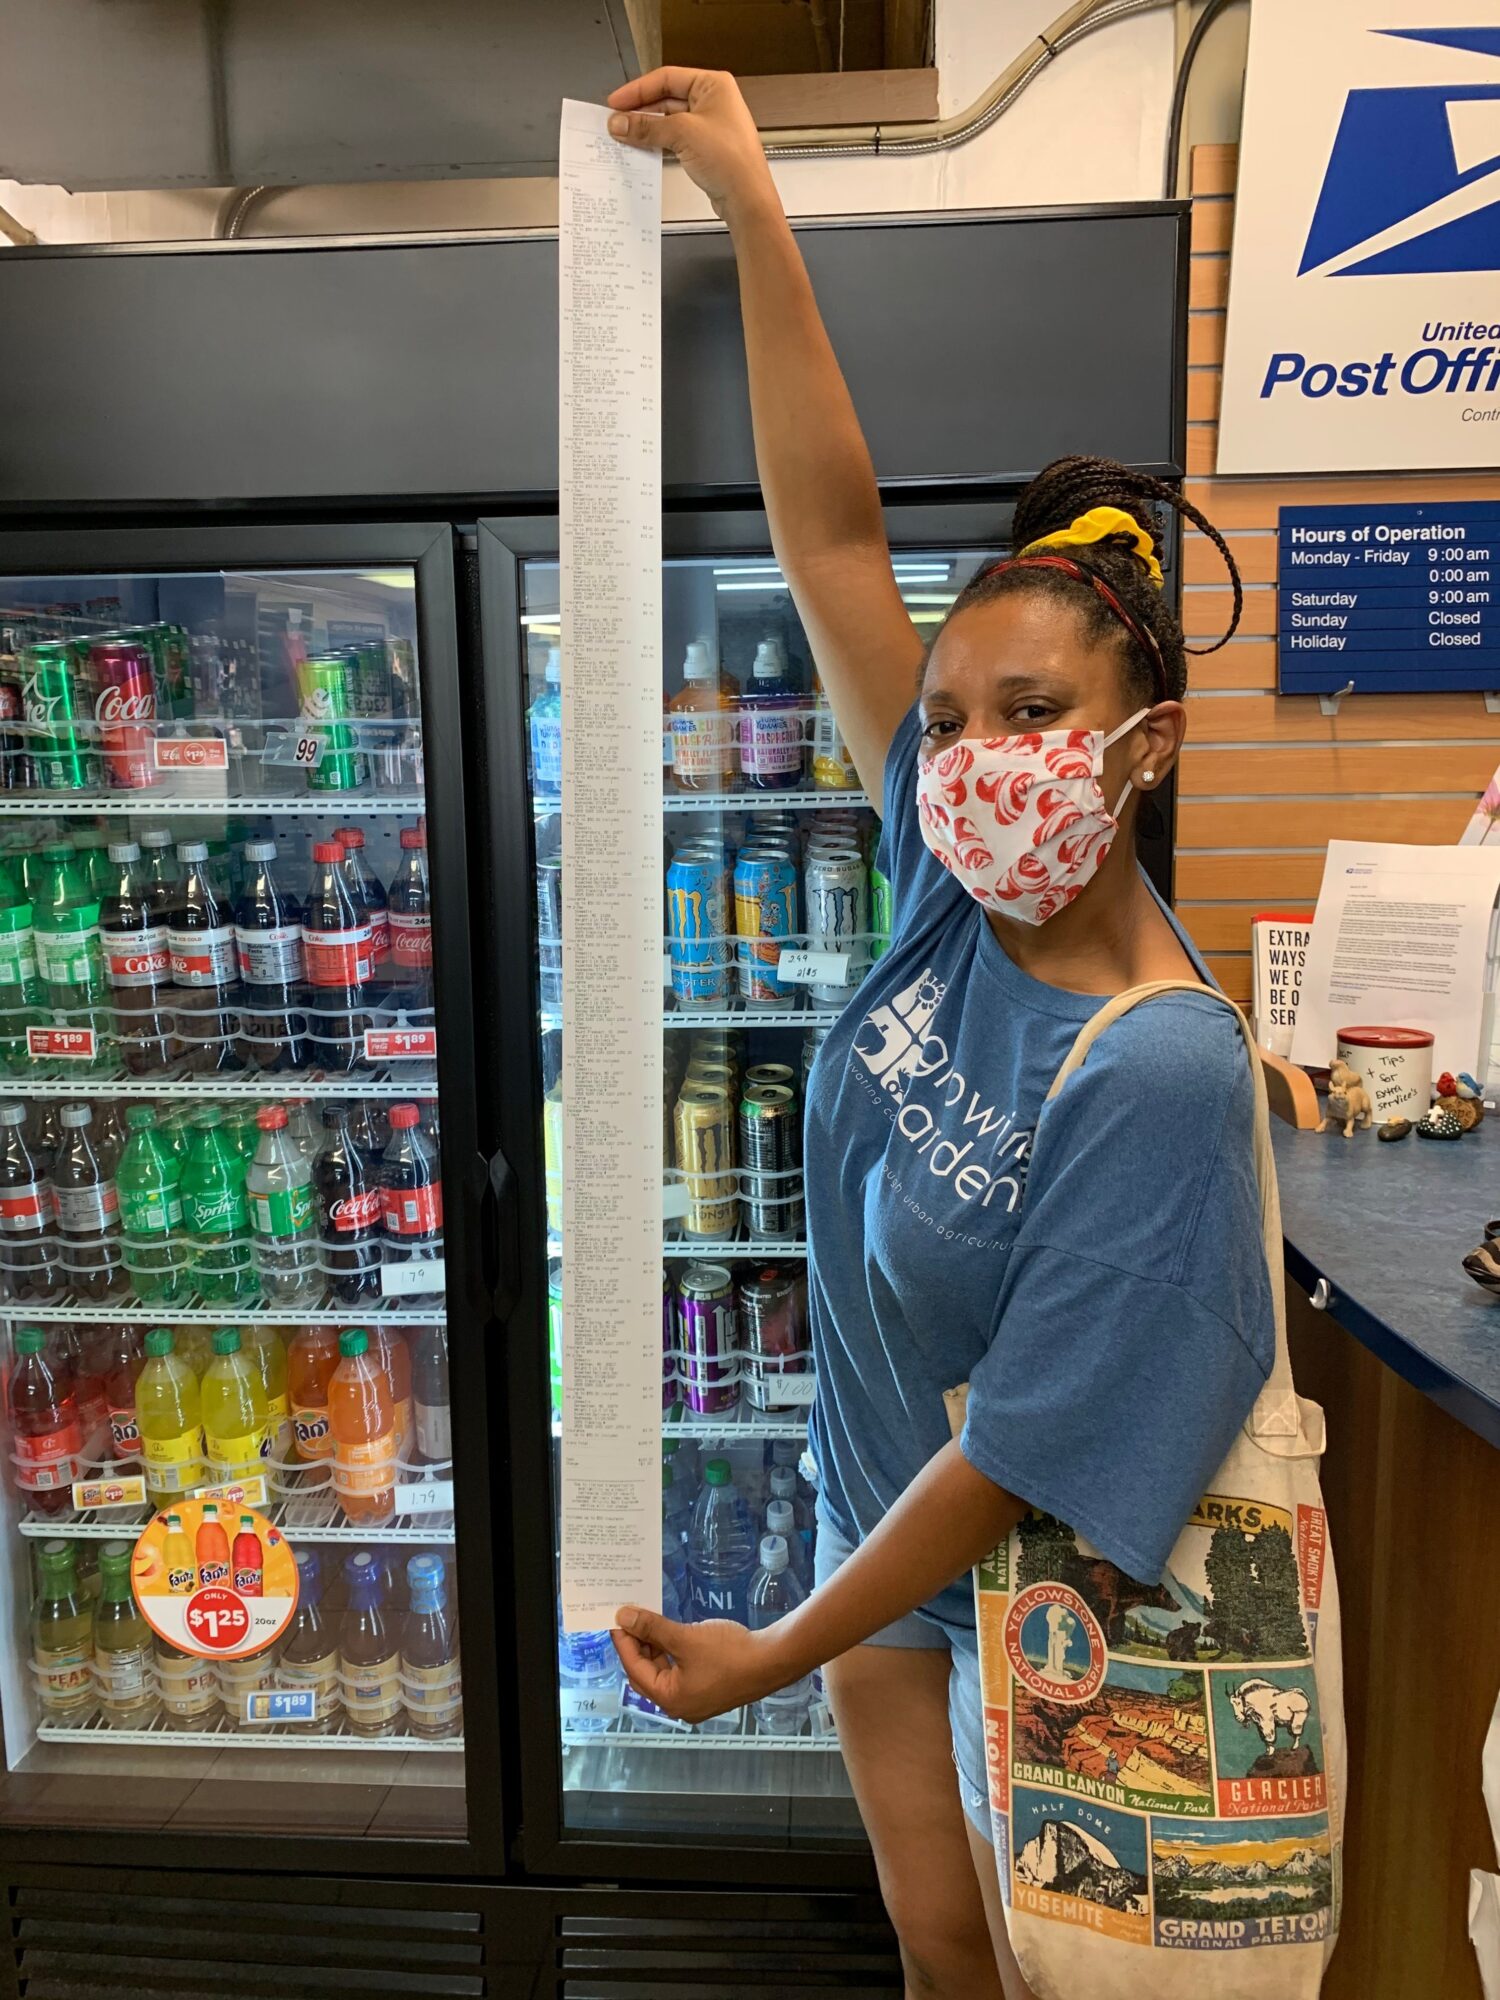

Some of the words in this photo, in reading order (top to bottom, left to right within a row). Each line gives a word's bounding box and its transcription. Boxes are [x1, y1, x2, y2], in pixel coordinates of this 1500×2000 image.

[1260, 353, 1396, 399] Post
[1291, 527, 1346, 543] Hours
[1351, 526, 1369, 541] of
[1375, 525, 1466, 544] Operation
[1291, 551, 1350, 566] Monday
[1364, 549, 1410, 565] Friday
[1466, 549, 1490, 561] am
[1466, 570, 1490, 582] am
[1291, 592, 1357, 608] Saturday
[1466, 591, 1490, 603] am
[1291, 613, 1348, 629] Sunday
[1428, 611, 1480, 625] Closed
[1291, 635, 1346, 650] Holiday
[1429, 632, 1481, 646] Closed
[296, 739, 317, 762] 99
[1269, 929, 1310, 948] EXTRA
[125, 956, 167, 974] Coke
[1269, 949, 1306, 967] WAYS
[1269, 969, 1289, 986] WE
[1270, 989, 1286, 1006] BE
[1378, 1055, 1406, 1068] Tips
[1376, 1084, 1403, 1099] Extra
[903, 1194, 935, 1227] urban
[1309, 1510, 1323, 1546] GREAT
[1306, 1547, 1321, 1584] SMOKY
[203, 1593, 228, 1601] ONLY
[1306, 1587, 1318, 1603] MT
[1007, 1589, 1101, 1649] YELLOWSTONE
[1009, 1642, 1075, 1698] NATIONAL
[1078, 1662, 1102, 1696] PARK
[986, 1719, 1000, 1799] ZION
[1013, 1763, 1064, 1793] GRAND
[1066, 1773, 1126, 1805] CANYON
[1128, 1793, 1180, 1812] National
[1184, 1801, 1211, 1814] Park
[1231, 1774, 1323, 1802] GLACIER
[1228, 1801, 1292, 1816] National
[1032, 1803, 1065, 1815] HALF
[1078, 1808, 1112, 1835] DOME
[1016, 1888, 1104, 1928] YOSEMITE
[1159, 1919, 1245, 1939] GRAND
[1255, 1909, 1330, 1935] TETON
[1160, 1936, 1243, 1948] NATIONAL
[1251, 1933, 1297, 1945] PARK
